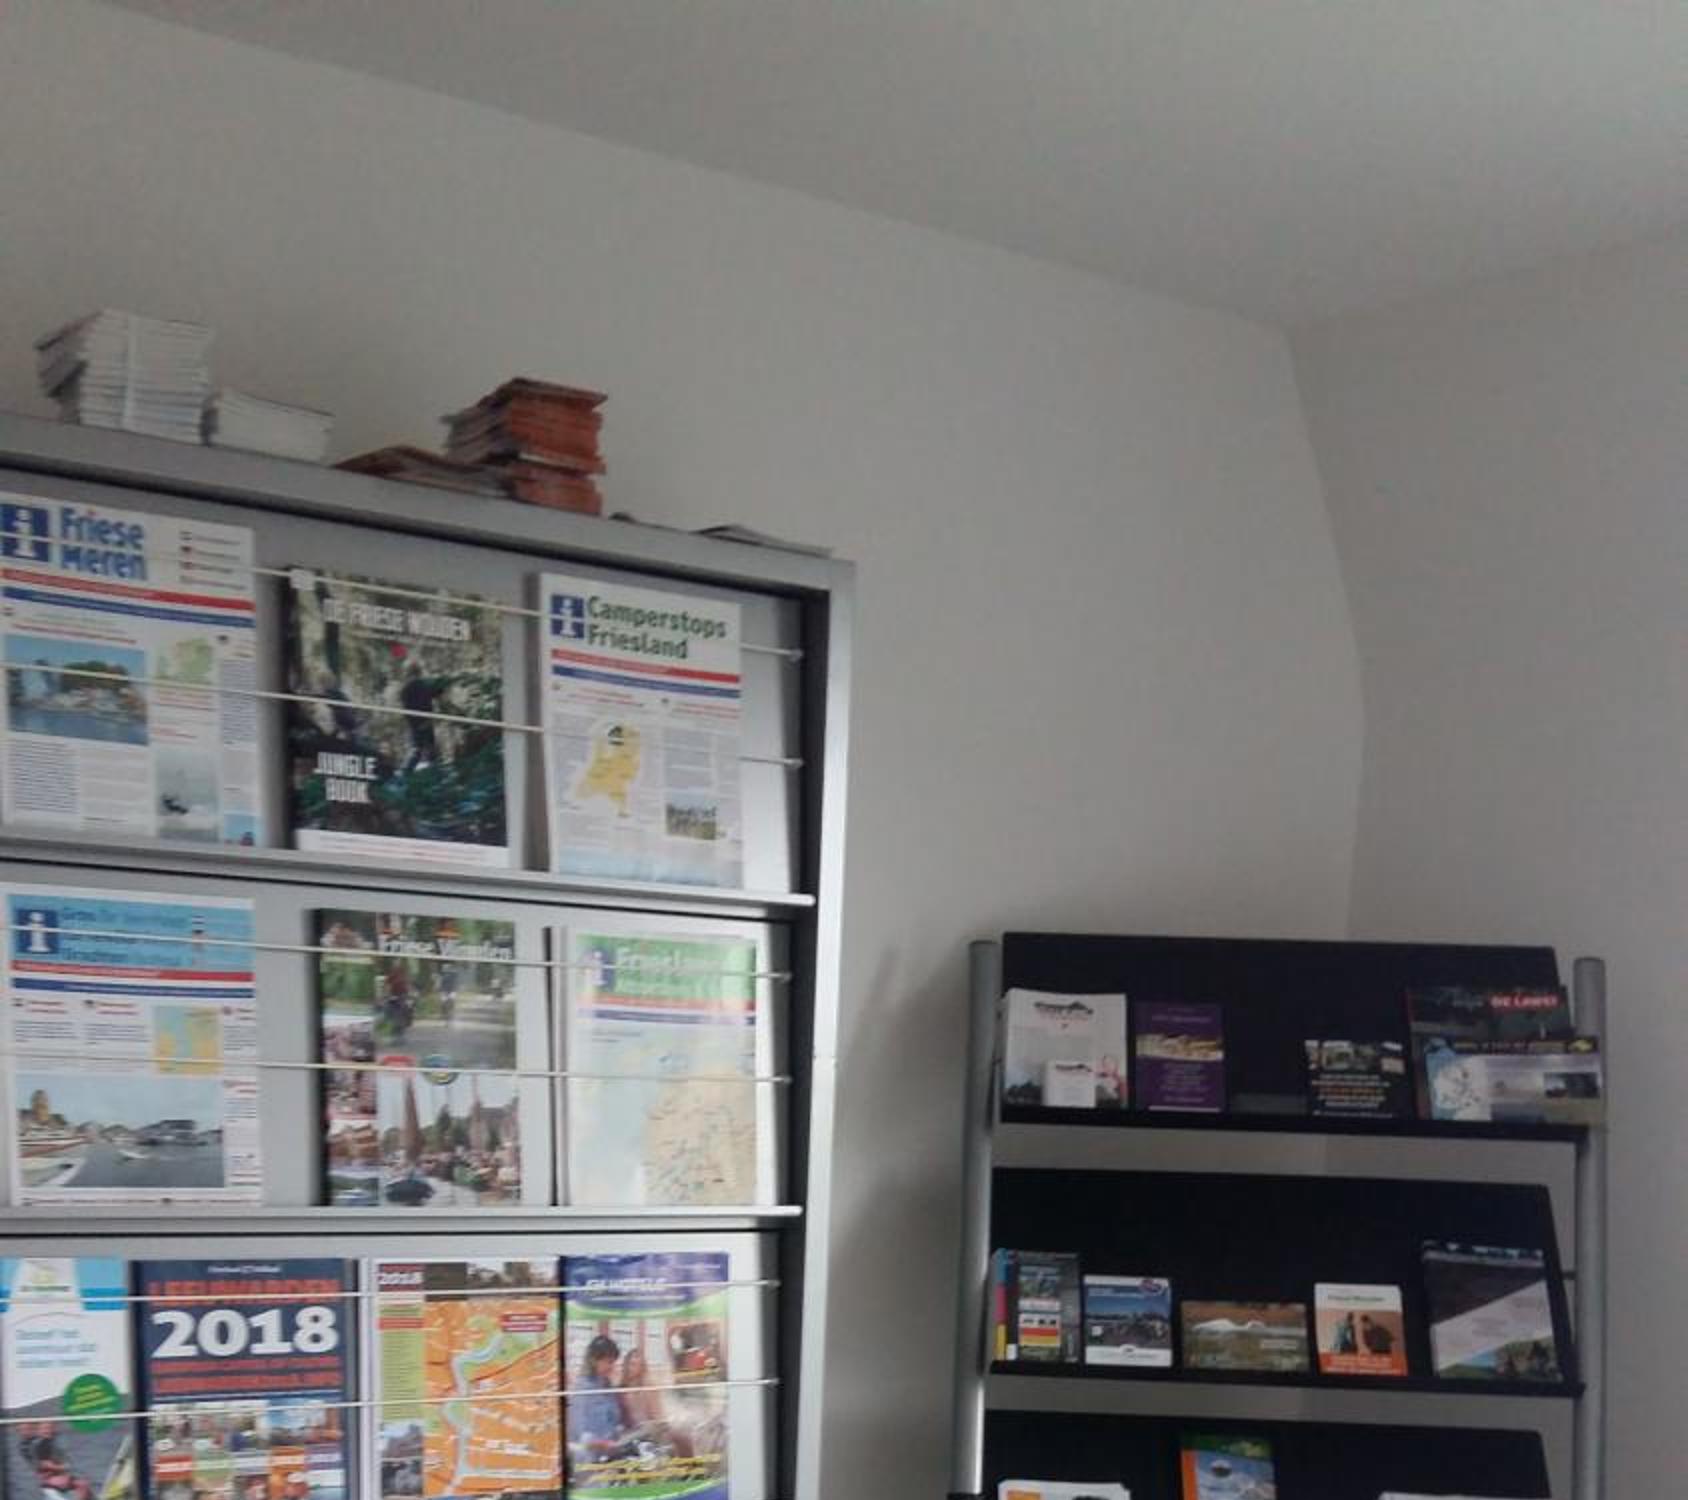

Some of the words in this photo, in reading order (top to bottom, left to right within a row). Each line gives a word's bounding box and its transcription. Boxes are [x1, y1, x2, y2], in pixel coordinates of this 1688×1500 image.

[59, 505, 145, 552] Friese
[60, 544, 147, 581] Meren
[351, 602, 404, 632] FRIESE
[586, 595, 728, 639] Camperstops
[586, 623, 690, 661] Friesland
[316, 750, 377, 779] JUNGLE
[325, 778, 371, 804] BOOK
[151, 1305, 341, 1359] 2018
